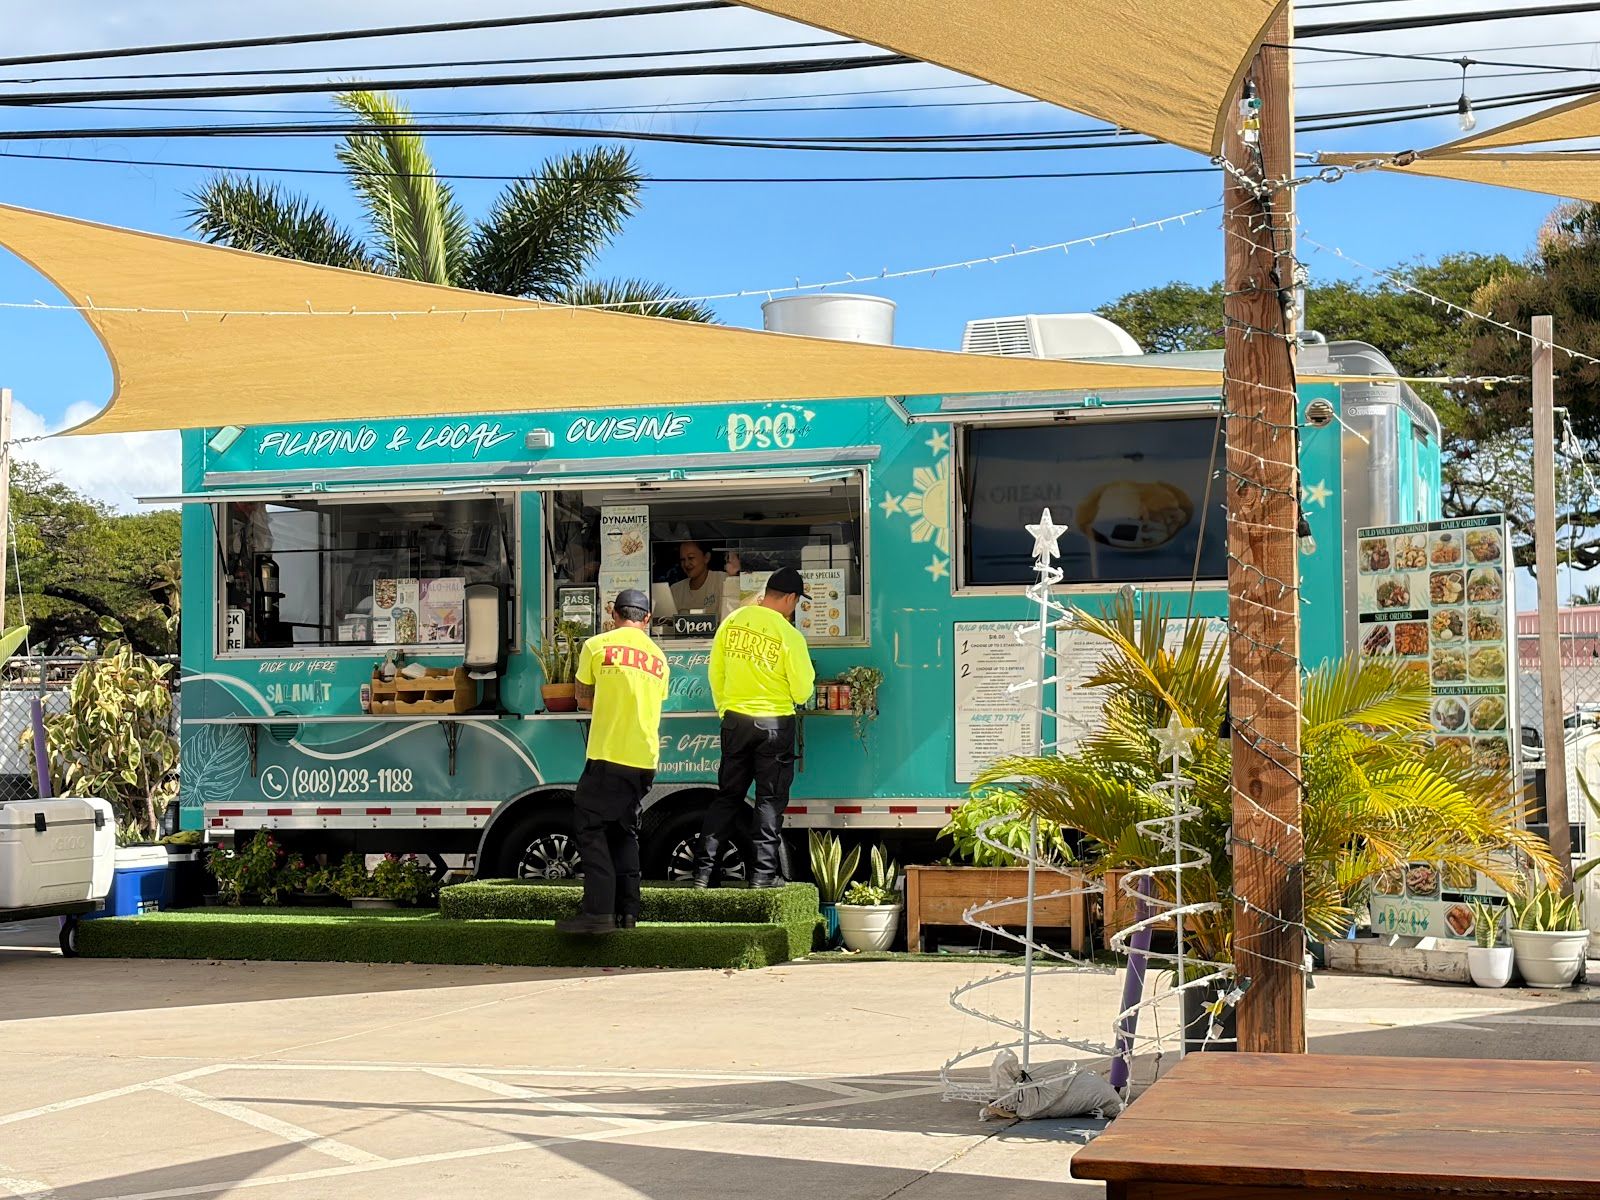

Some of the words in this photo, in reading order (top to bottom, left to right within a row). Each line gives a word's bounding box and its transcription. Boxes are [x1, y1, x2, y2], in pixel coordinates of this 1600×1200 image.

[258, 425, 377, 456] FILIPINO
[386, 426, 411, 451] &
[415, 423, 516, 459] LOCAL
[566, 412, 692, 443] CUISINE
[602, 515, 647, 525] DYNAMITE
[1440, 520, 1460, 530] DAILY
[1461, 518, 1488, 528] GRINDZ
[815, 571, 841, 580] SPECIALS
[564, 595, 590, 604] PASS
[226, 615, 240, 625] CK
[1374, 613, 1388, 622] SIDE
[1389, 611, 1413, 620] ORDERS
[675, 617, 715, 634] Open
[227, 639, 241, 649] RE
[724, 628, 782, 664] FIRE
[960, 640, 969, 655] 1
[258, 661, 287, 673] PICK
[289, 661, 305, 673] UP
[307, 660, 339, 675] HERE
[601, 646, 664, 680] FIRE
[961, 663, 971, 678] 2
[265, 680, 332, 704] SALAMAT
[1437, 687, 1456, 695] LOCAL
[1456, 686, 1476, 695] STYLE
[659, 735, 673, 748] E
[677, 734, 721, 757] CATE
[292, 766, 413, 798] (808)283-1188
